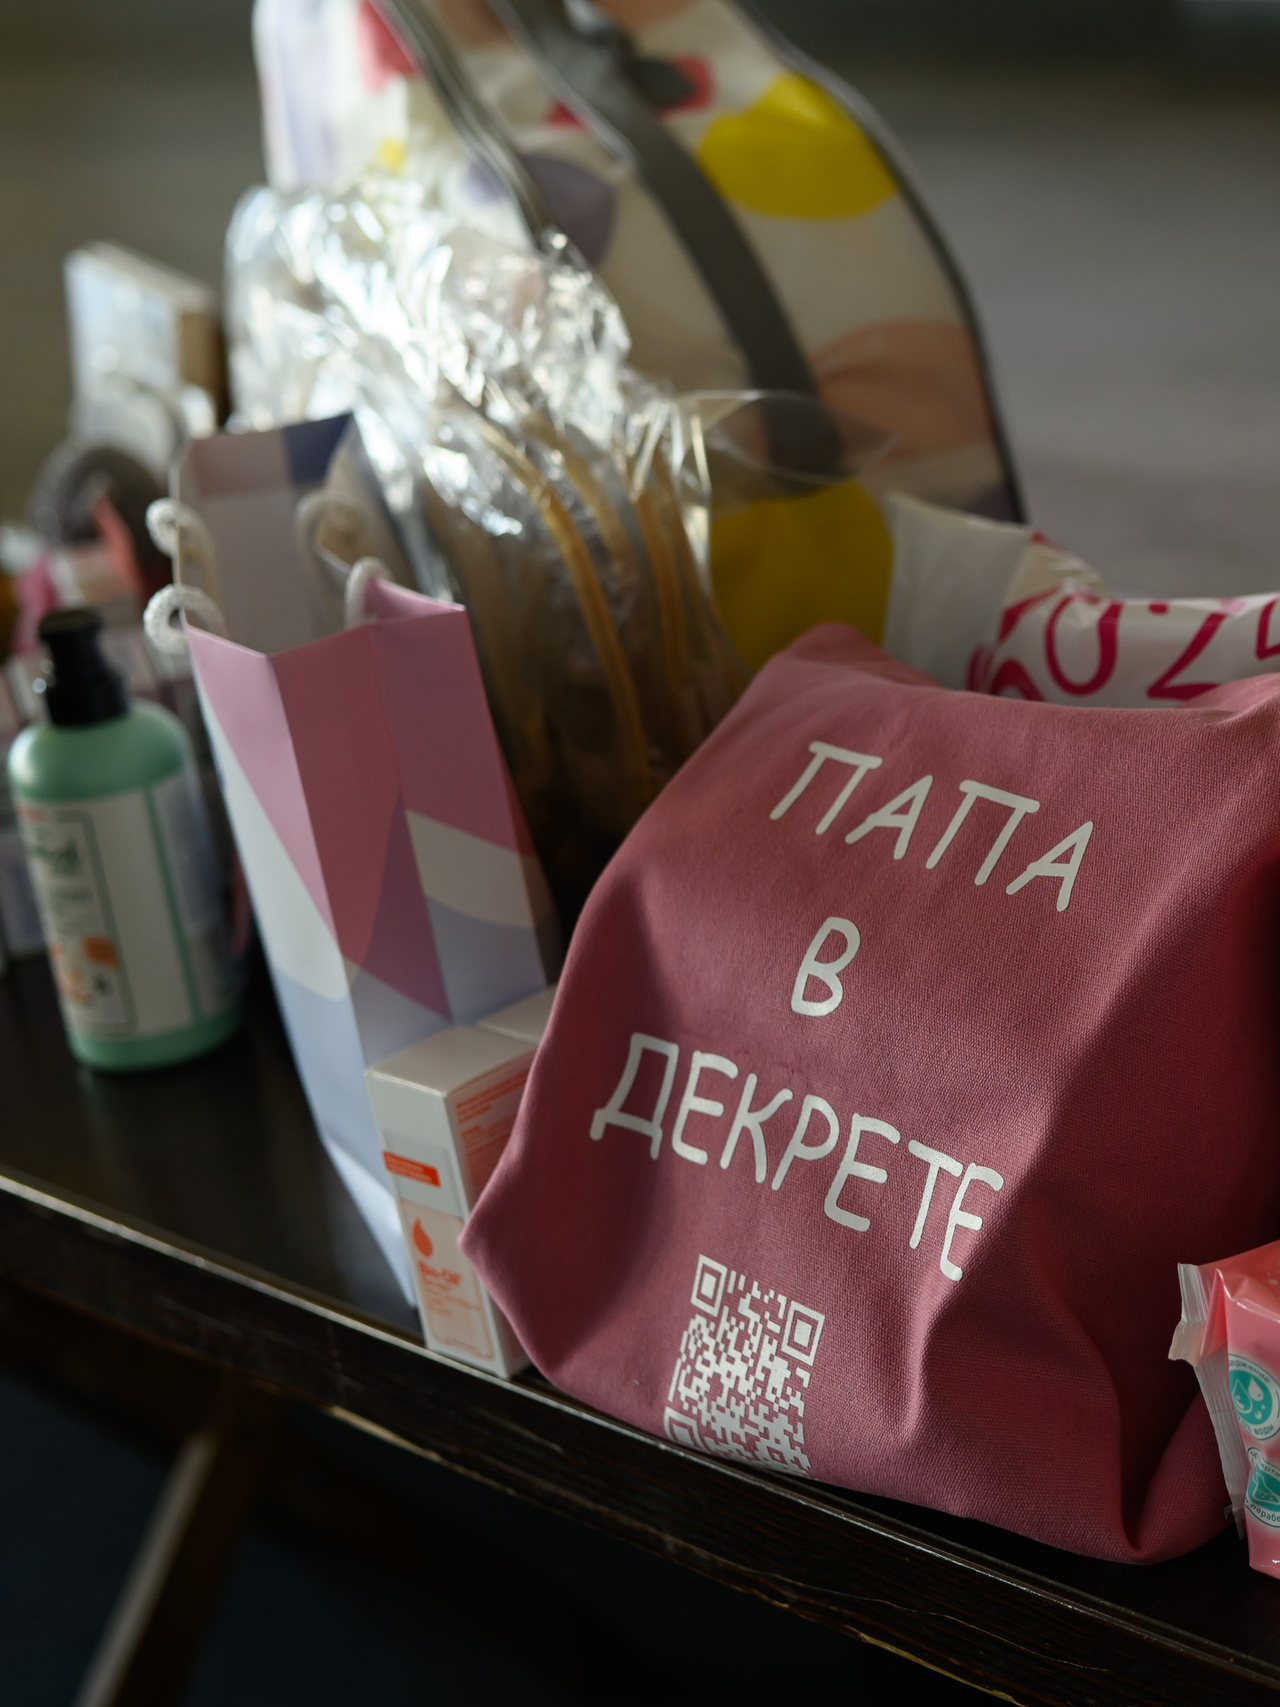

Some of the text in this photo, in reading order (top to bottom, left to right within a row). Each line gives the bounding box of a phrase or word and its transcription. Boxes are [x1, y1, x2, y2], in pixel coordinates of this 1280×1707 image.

[769, 740, 1094, 912] ПАПА
[790, 916, 861, 1017] В
[589, 1031, 1005, 1282] ДЕКРЕТЕ
